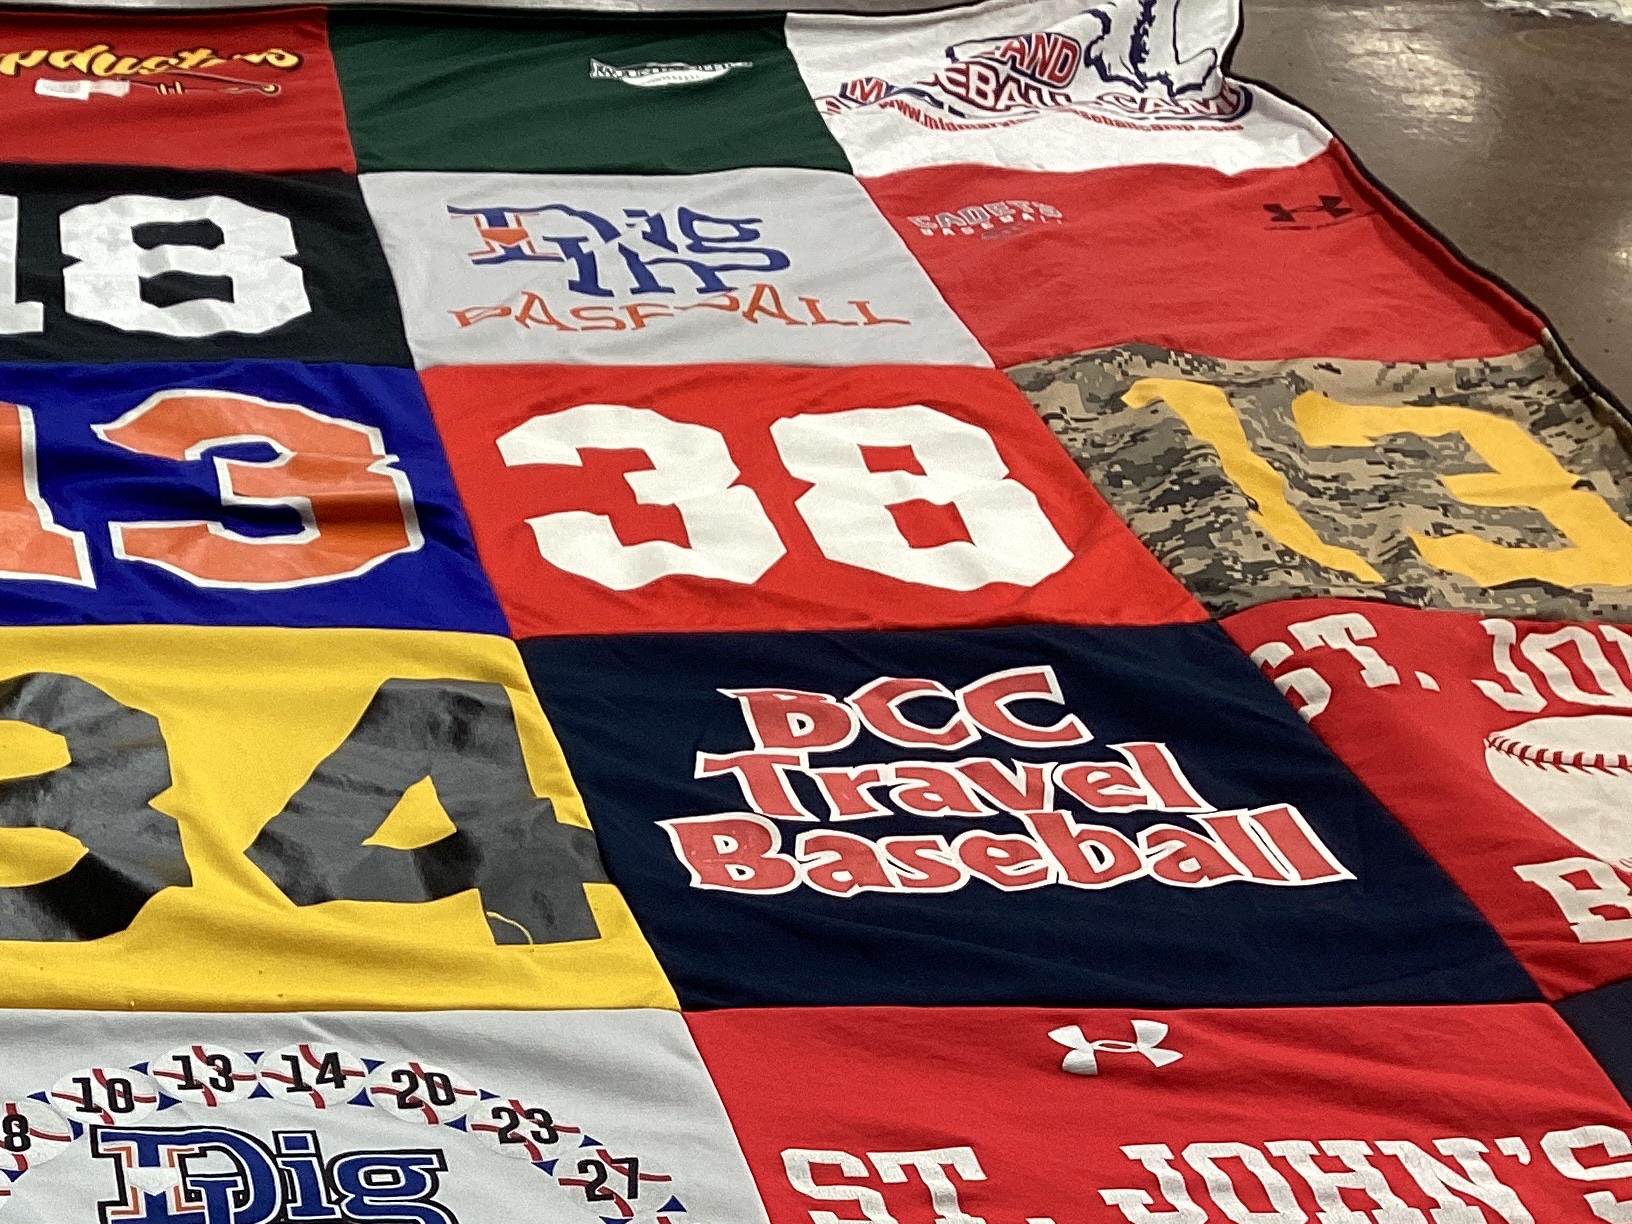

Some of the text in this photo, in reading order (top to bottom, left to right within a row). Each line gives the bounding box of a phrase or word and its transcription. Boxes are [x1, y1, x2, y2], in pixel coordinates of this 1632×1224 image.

[906, 199, 1064, 230] CADETS
[495, 403, 1075, 592] 38
[1120, 377, 1632, 588] 13
[716, 664, 1095, 753] DCC
[694, 741, 1218, 823] Travel
[654, 803, 1357, 897] Baseball
[171, 1053, 235, 1093] 13
[280, 1051, 348, 1093] 14
[390, 1071, 456, 1108] 20
[71, 1076, 136, 1115] 10
[1, 1114, 32, 1153] 8
[491, 1105, 561, 1145] 23
[576, 1156, 640, 1202] 27
